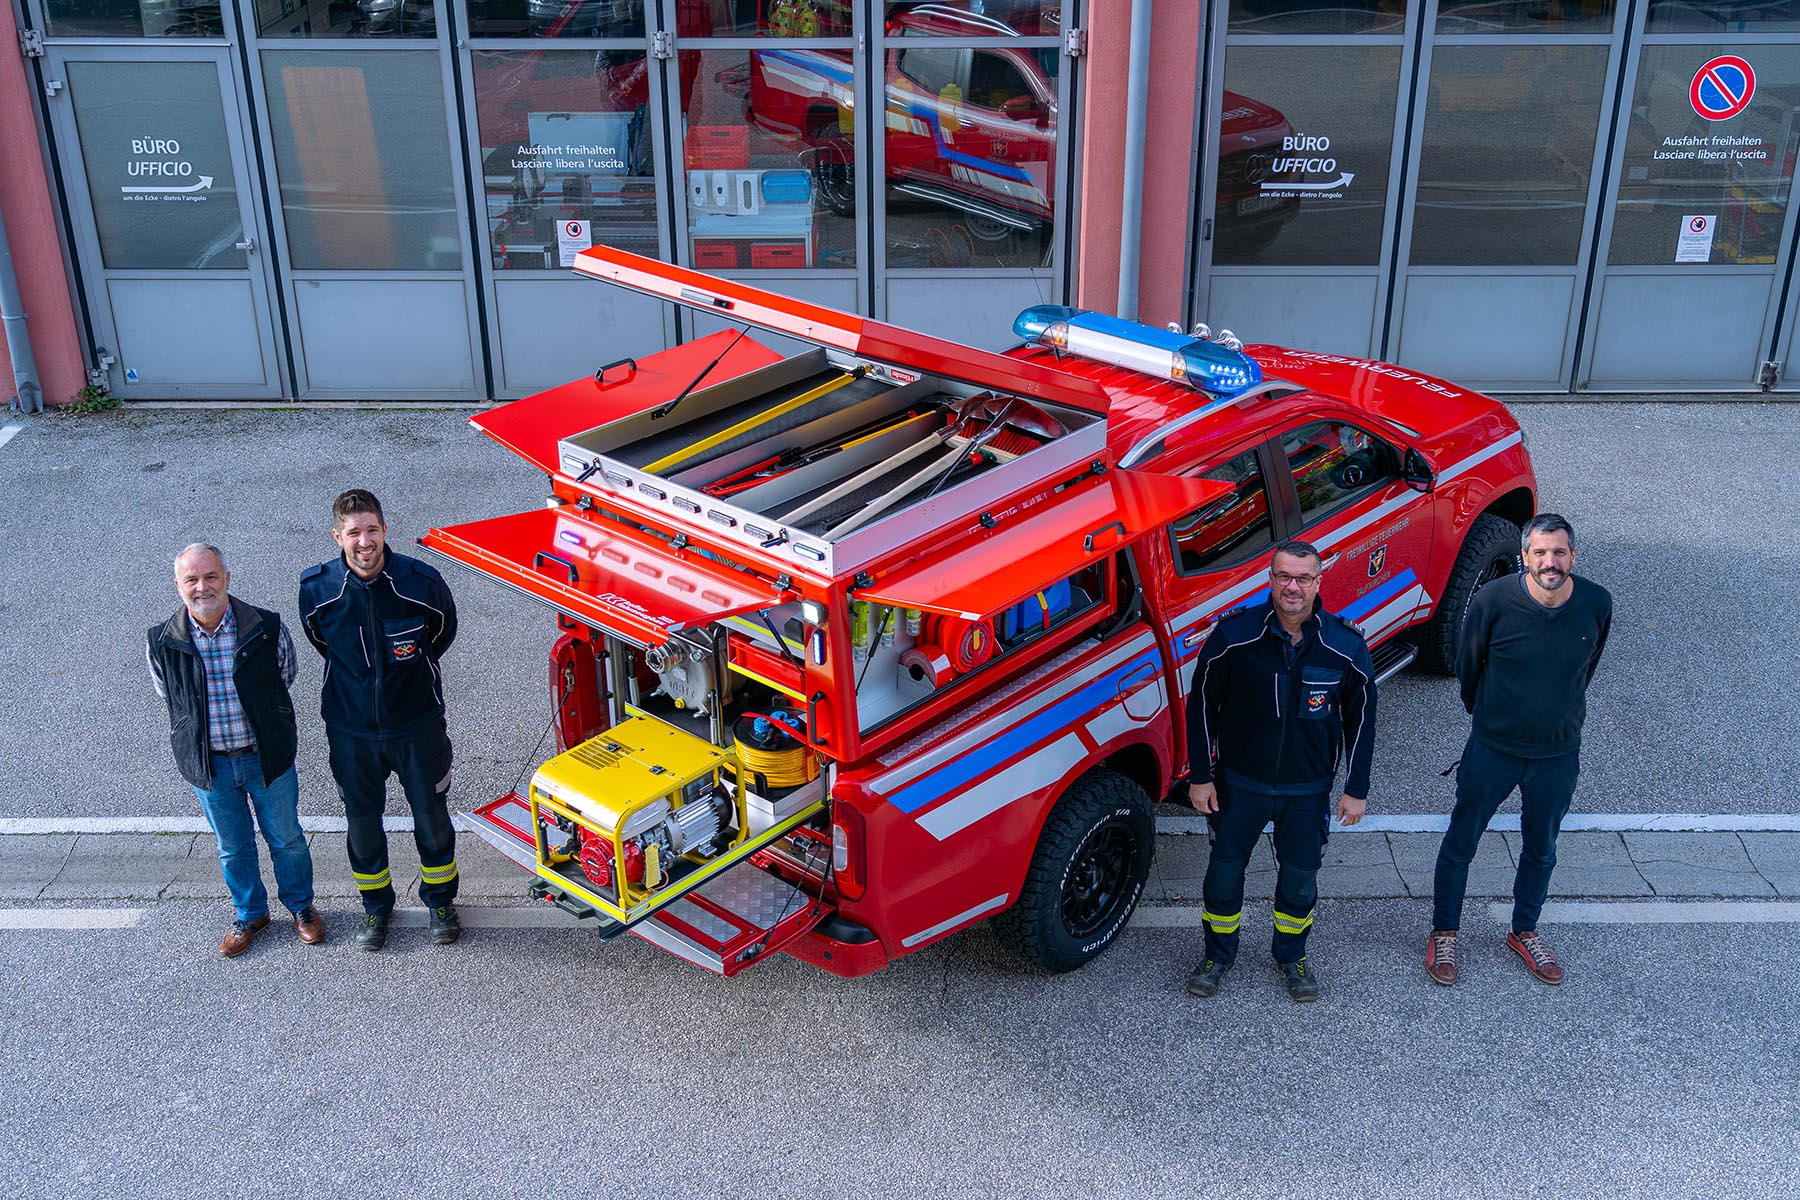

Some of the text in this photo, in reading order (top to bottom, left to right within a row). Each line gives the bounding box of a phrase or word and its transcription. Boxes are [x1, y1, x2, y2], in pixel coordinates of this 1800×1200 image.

[131, 136, 180, 154] BÜRO
[1283, 132, 1330, 151] BÜRO
[1662, 135, 1762, 146] Ausfahrt freihalten
[517, 145, 616, 155] Ausfahrt freihalten
[1653, 149, 1695, 160] Lasciare
[1697, 149, 1727, 160] libera
[127, 161, 192, 176] UFFICIO
[511, 158, 553, 169] Lasciare
[555, 158, 585, 169] libera
[1272, 158, 1337, 173] UFFICIO
[1282, 350, 1462, 399] FEUERWEHR
[1346, 517, 1410, 562] FREIWILLIGE FEUERWEHR
[1115, 808, 1131, 816] T/A
